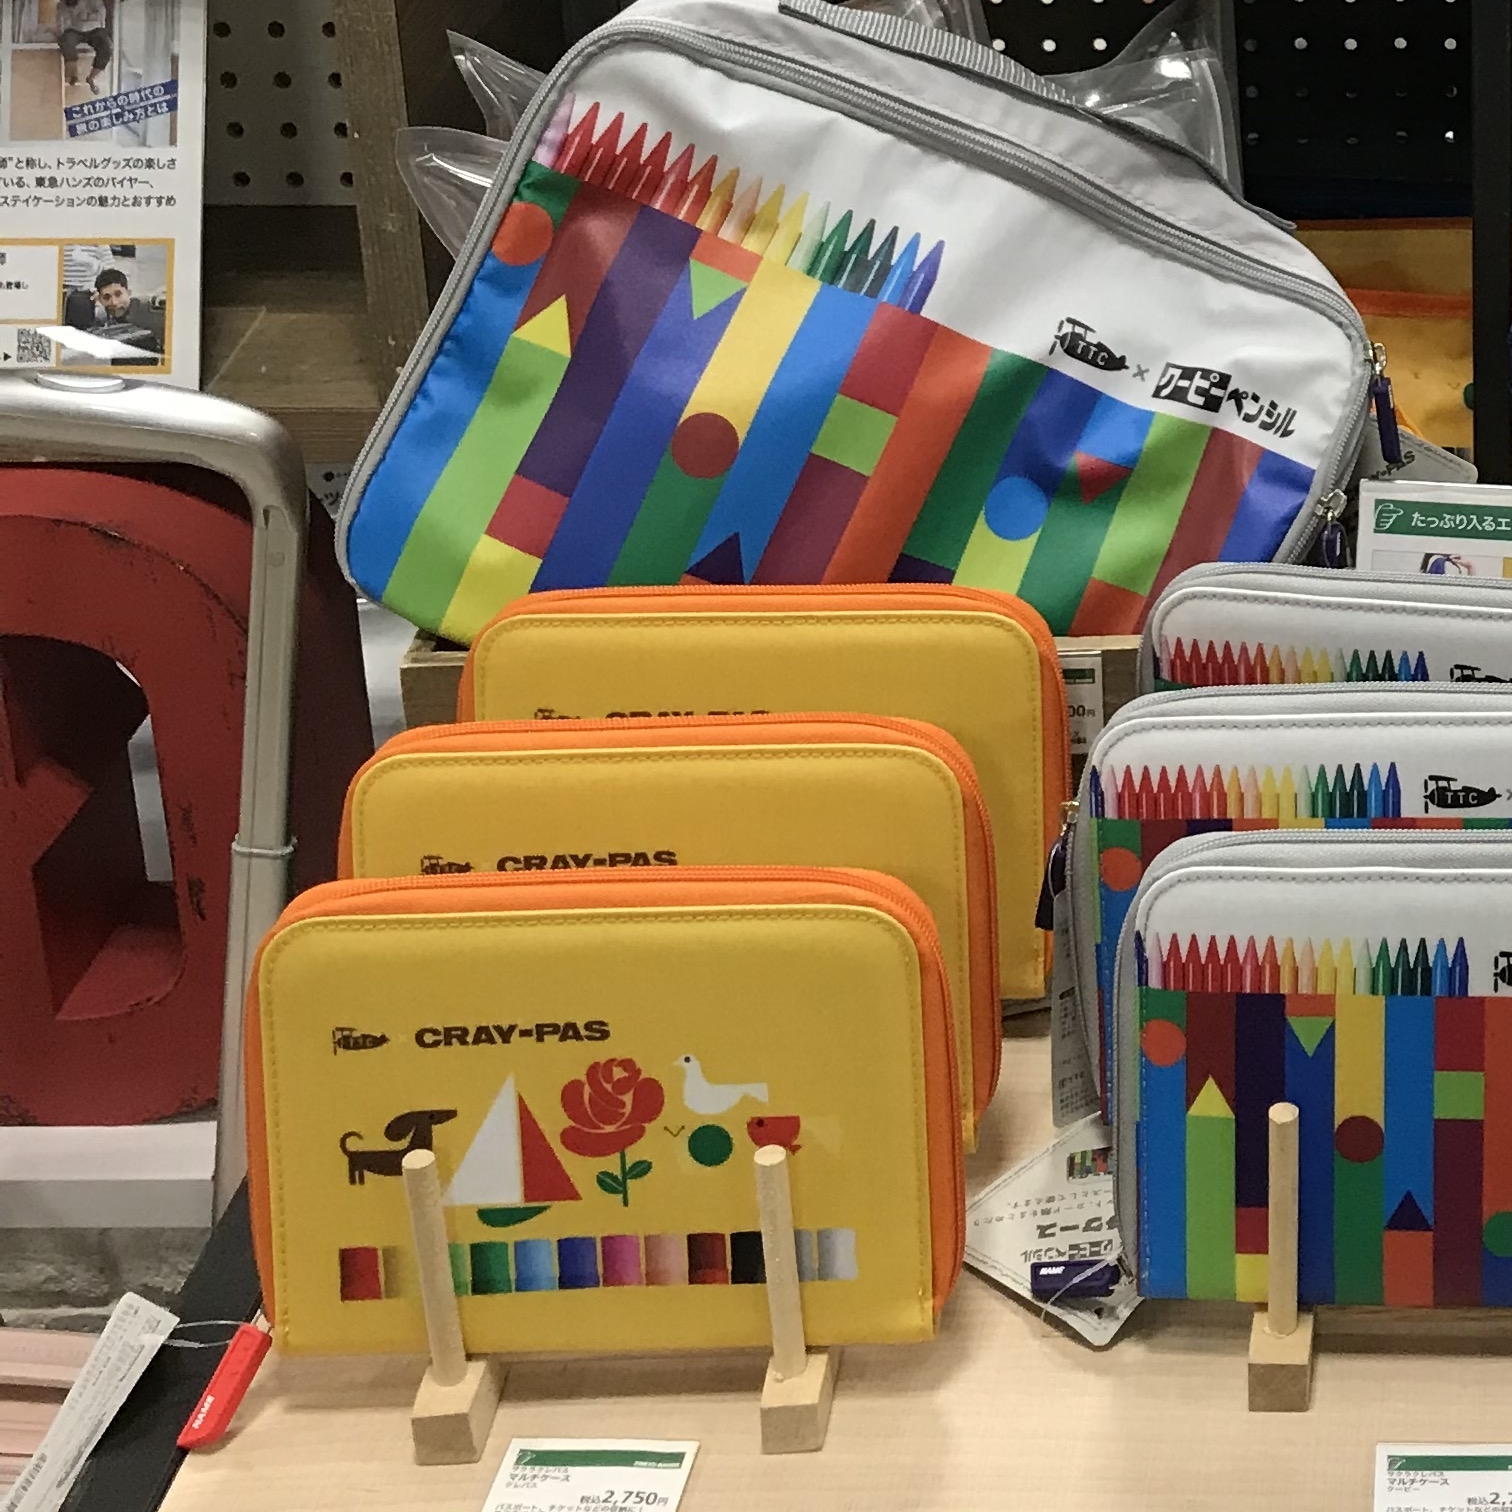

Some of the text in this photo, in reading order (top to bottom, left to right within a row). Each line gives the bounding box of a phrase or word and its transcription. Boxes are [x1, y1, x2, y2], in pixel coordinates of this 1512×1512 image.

[70, 85, 165, 118] これからの時代の
[1076, 340, 1110, 366] TTC
[1152, 362, 1297, 438] クーピーペンシル
[1445, 790, 1478, 804] TTC
[496, 849, 678, 872] CRAY-PAS
[415, 1020, 611, 1049] CRAY-PAS
[508, 1473, 571, 1483] マルチケース
[1387, 1478, 1450, 1486] マルチケース
